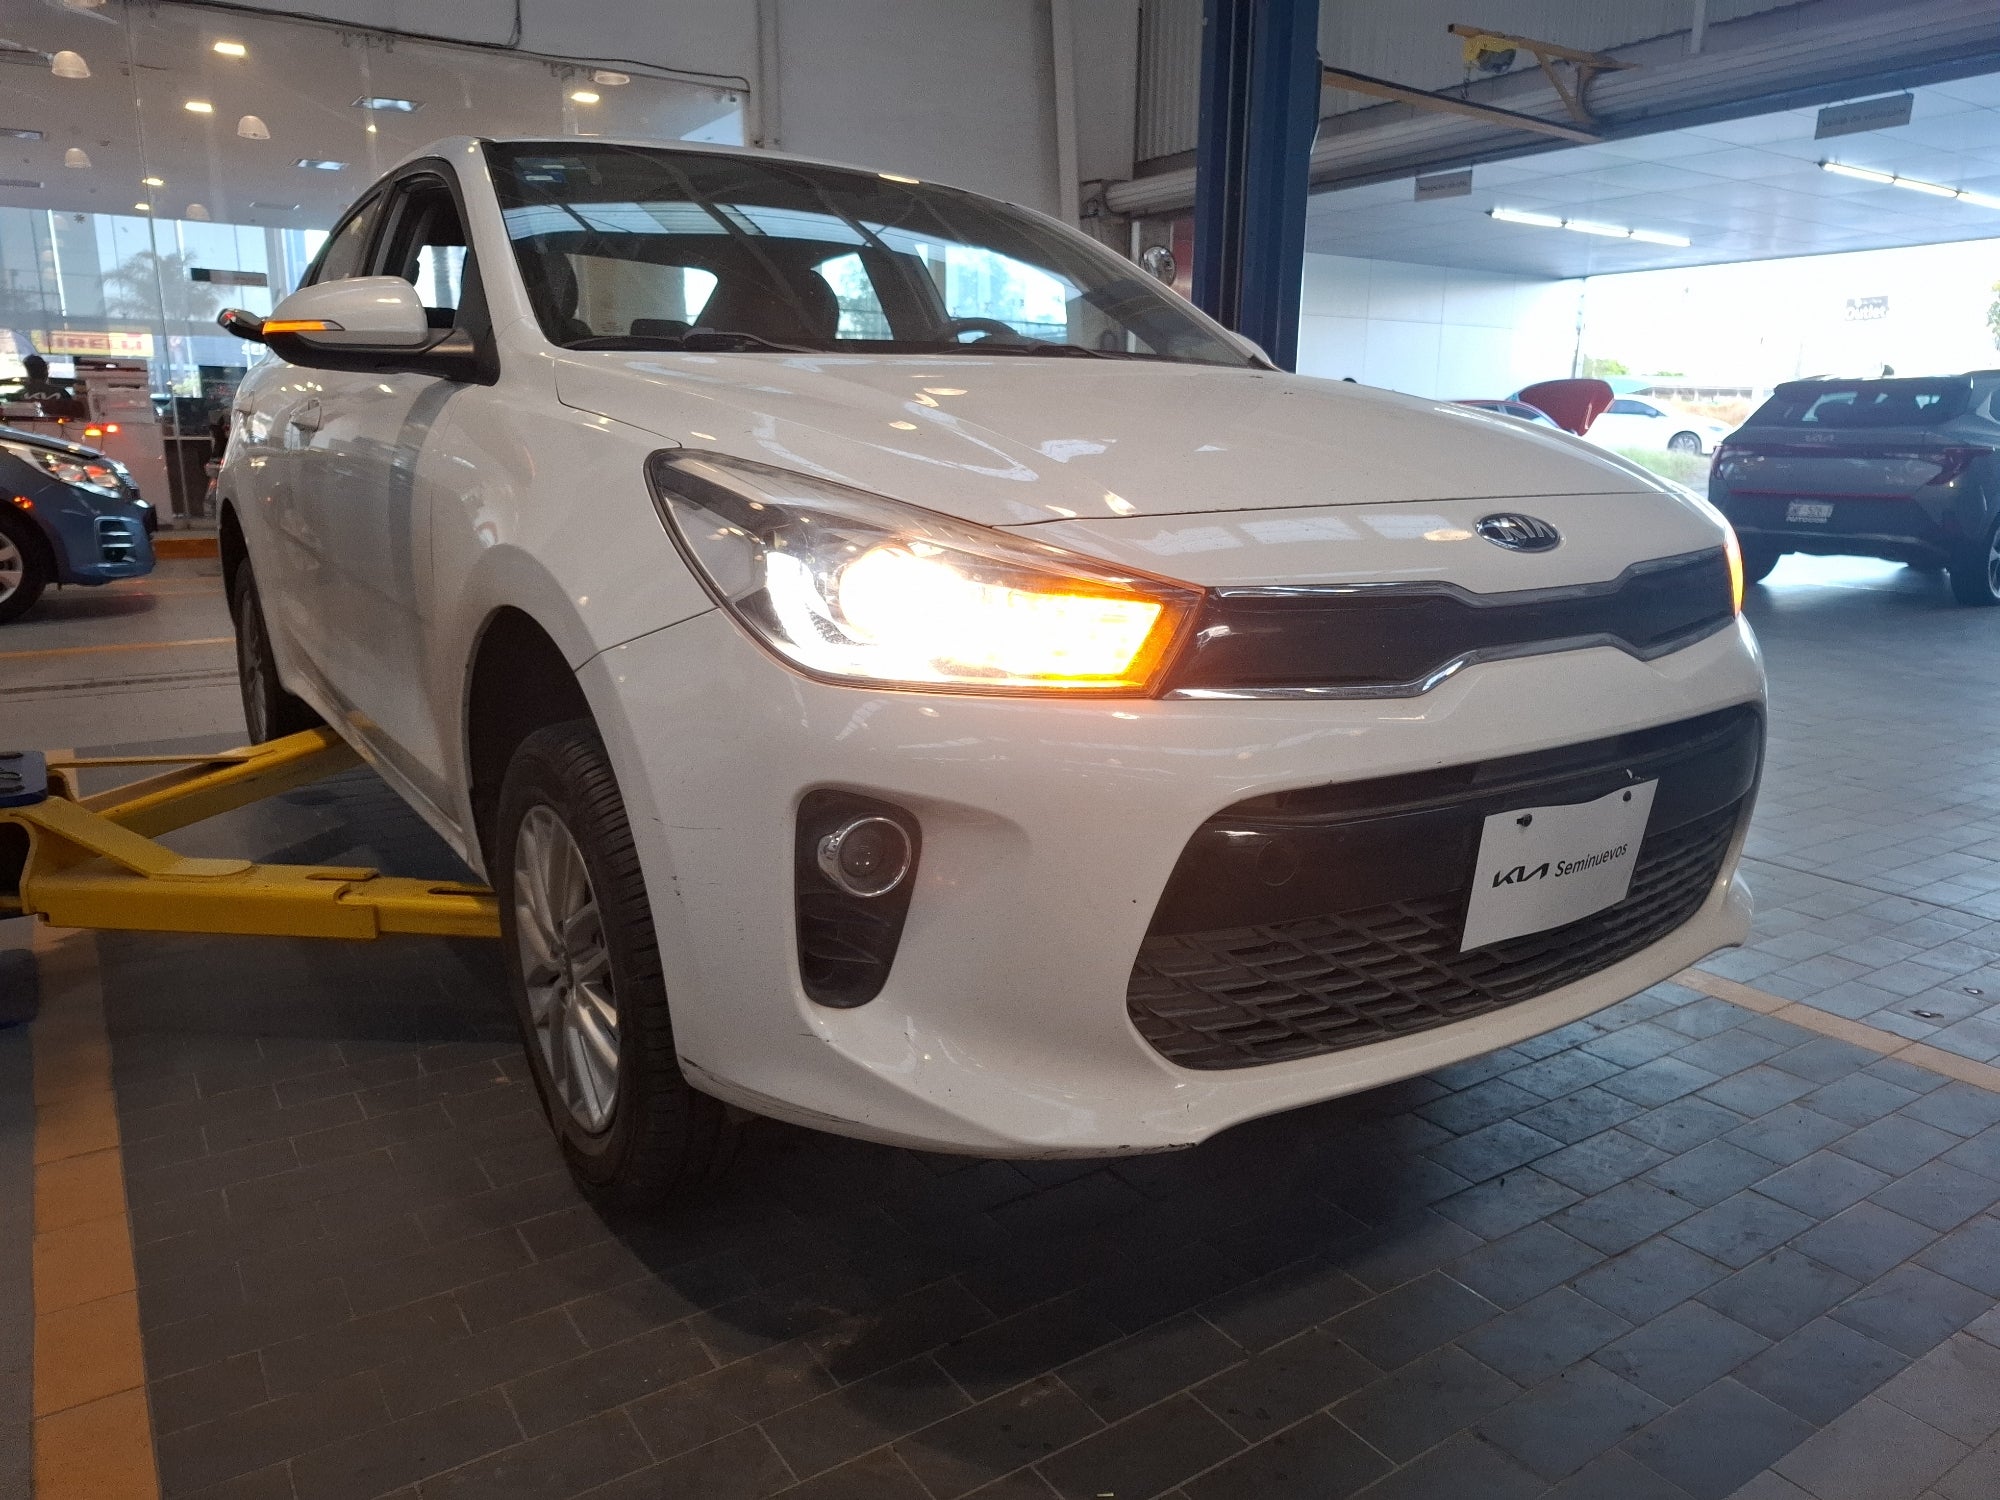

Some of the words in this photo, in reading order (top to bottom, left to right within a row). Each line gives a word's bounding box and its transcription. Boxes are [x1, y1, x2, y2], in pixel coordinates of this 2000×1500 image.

[43, 337, 142, 350] IRELI
[1496, 516, 1556, 542] KIA
[1491, 862, 1550, 888] KIA
[1554, 843, 1628, 877] Seminuevos
